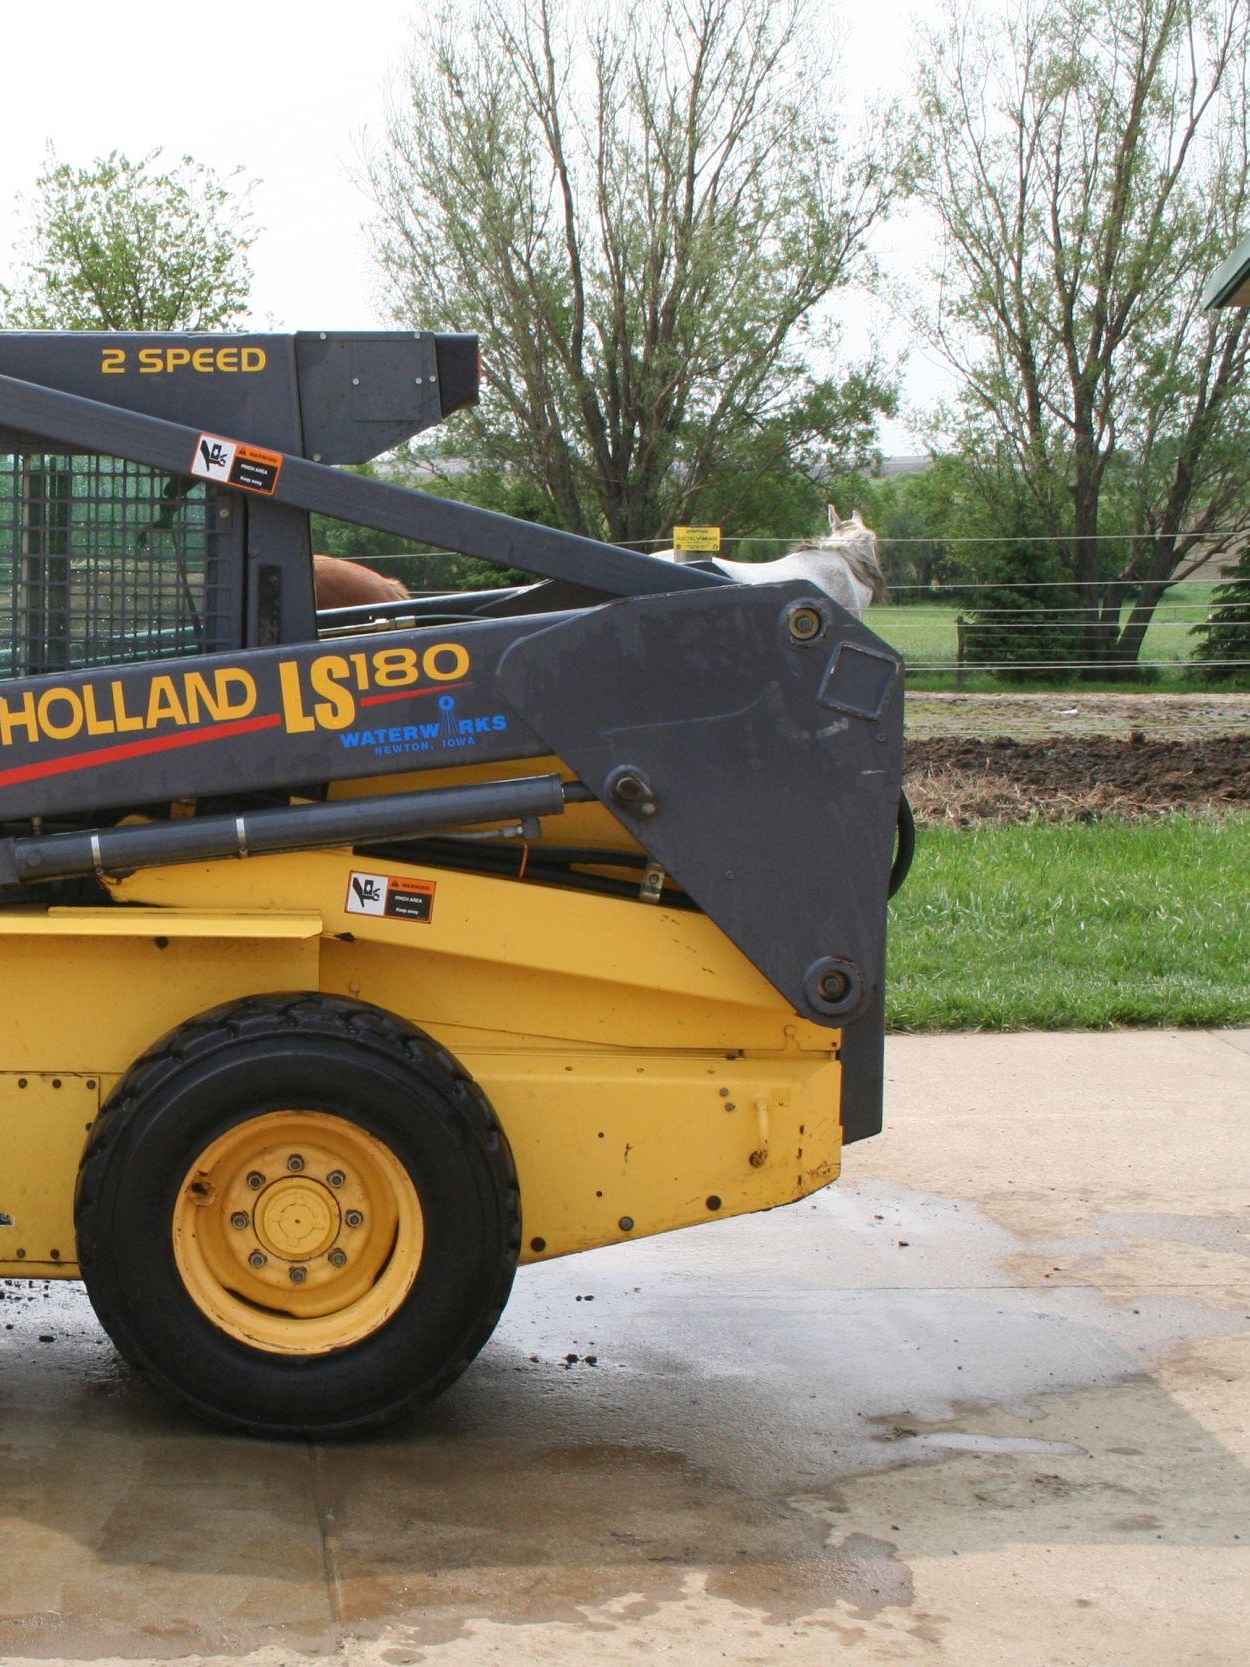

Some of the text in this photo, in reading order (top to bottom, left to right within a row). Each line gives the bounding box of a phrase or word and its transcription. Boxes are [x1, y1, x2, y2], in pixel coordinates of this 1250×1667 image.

[101, 348, 267, 374] 2 SPEED
[442, 736, 476, 748] IOWA
